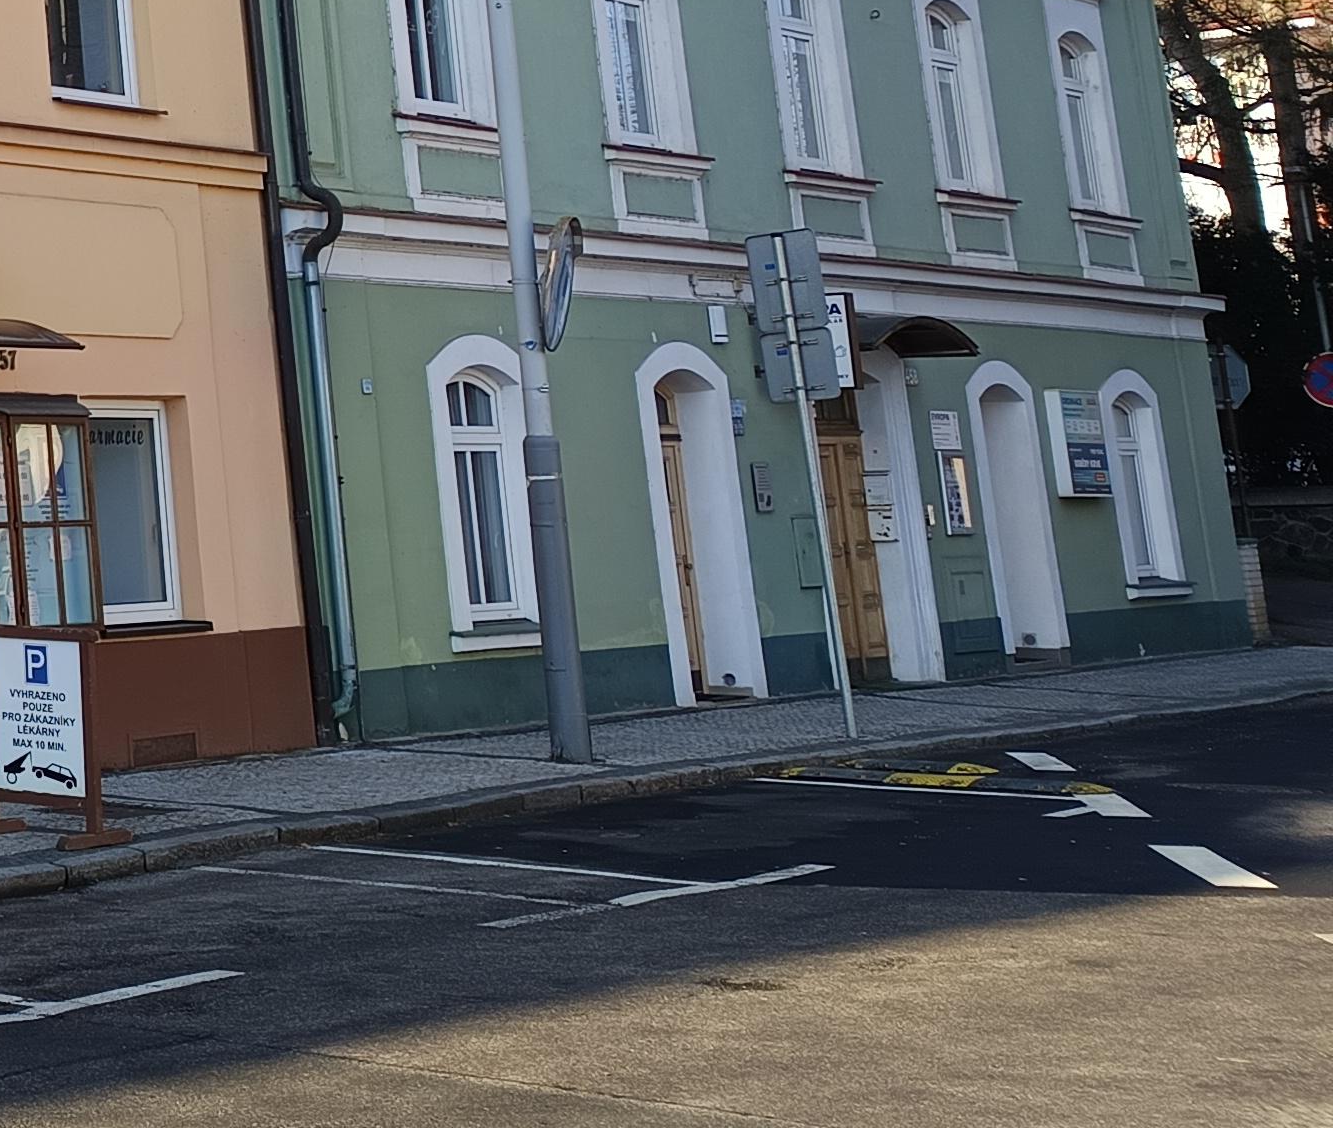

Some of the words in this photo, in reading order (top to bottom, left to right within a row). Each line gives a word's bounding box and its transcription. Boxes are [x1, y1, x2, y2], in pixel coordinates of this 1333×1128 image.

[89, 424, 144, 445] armacie
[26, 649, 45, 680] P
[9, 688, 66, 702] VYHRAZENO
[22, 701, 54, 713] POUZE
[1, 711, 21, 722] PRO
[23, 712, 76, 727] ZÁKAZNÍKY
[17, 724, 61, 738] LÉKÁRNY
[12, 738, 33, 748] MAX
[35, 740, 46, 750] 10
[47, 741, 67, 753] MIN.
